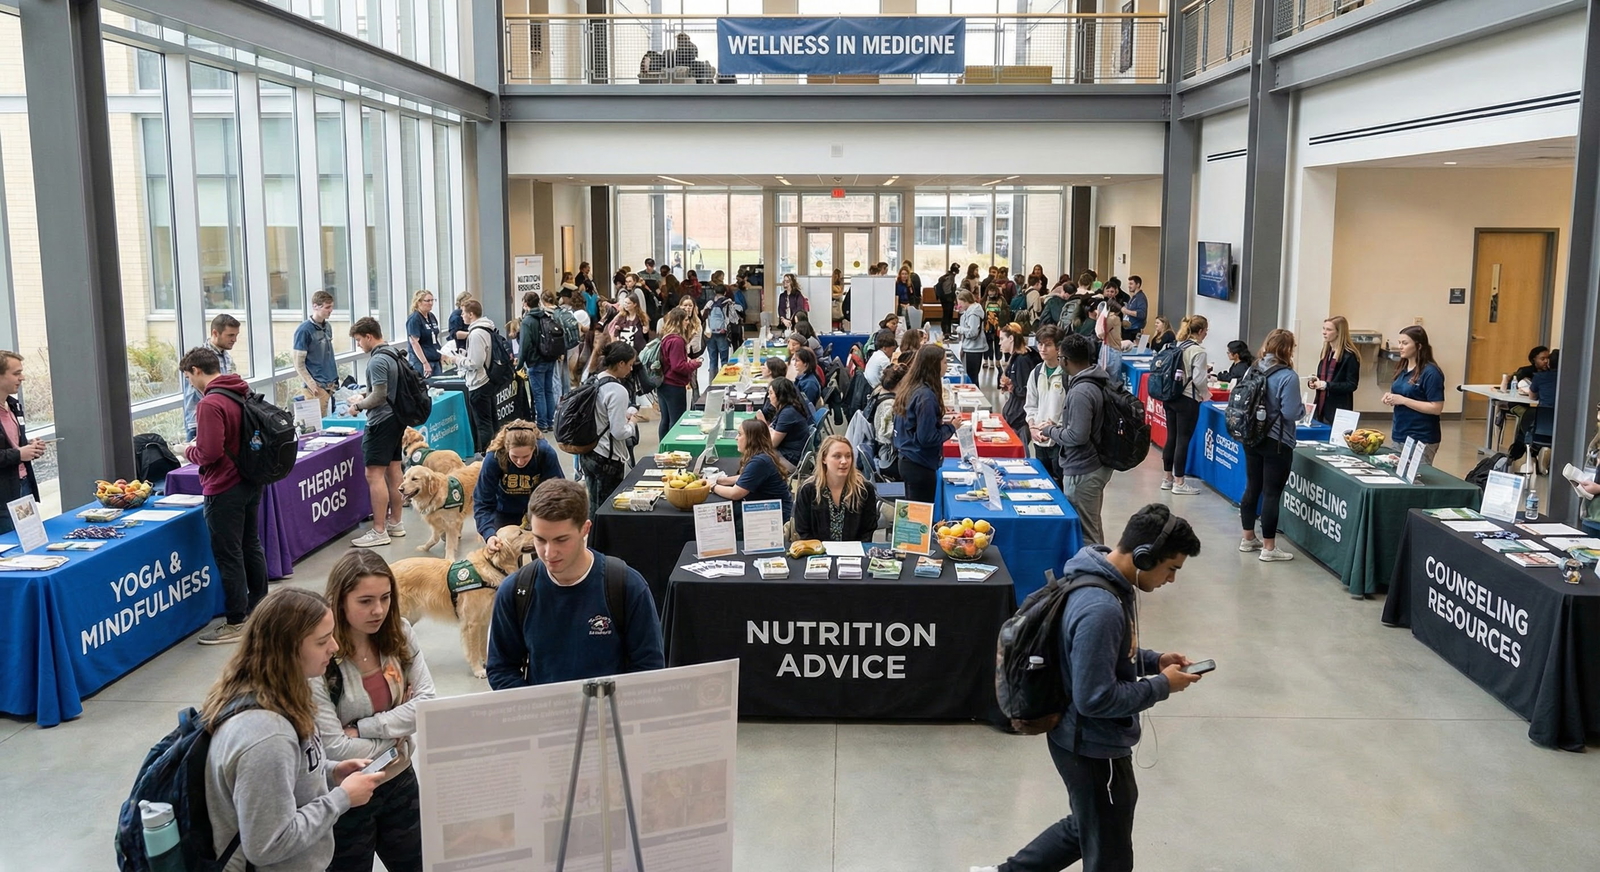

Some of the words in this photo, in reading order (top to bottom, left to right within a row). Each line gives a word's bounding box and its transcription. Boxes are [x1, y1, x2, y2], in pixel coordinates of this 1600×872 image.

[728, 35, 829, 55] WELLNESS
[836, 35, 856, 55] IN
[862, 35, 955, 55] MEDICINE
[298, 456, 355, 501] THERAPY
[1285, 470, 1347, 520] OUNSELING
[311, 488, 347, 523] DOGS
[1283, 491, 1342, 543] RESOURCES
[110, 559, 166, 603] YOGA
[169, 551, 182, 574] &
[1425, 556, 1529, 636] COUNSELING
[80, 565, 211, 656] MINDFULNESS
[746, 620, 937, 647] NUTRITION
[1428, 586, 1522, 668] RESOURCES
[776, 653, 906, 679] ADVICE
